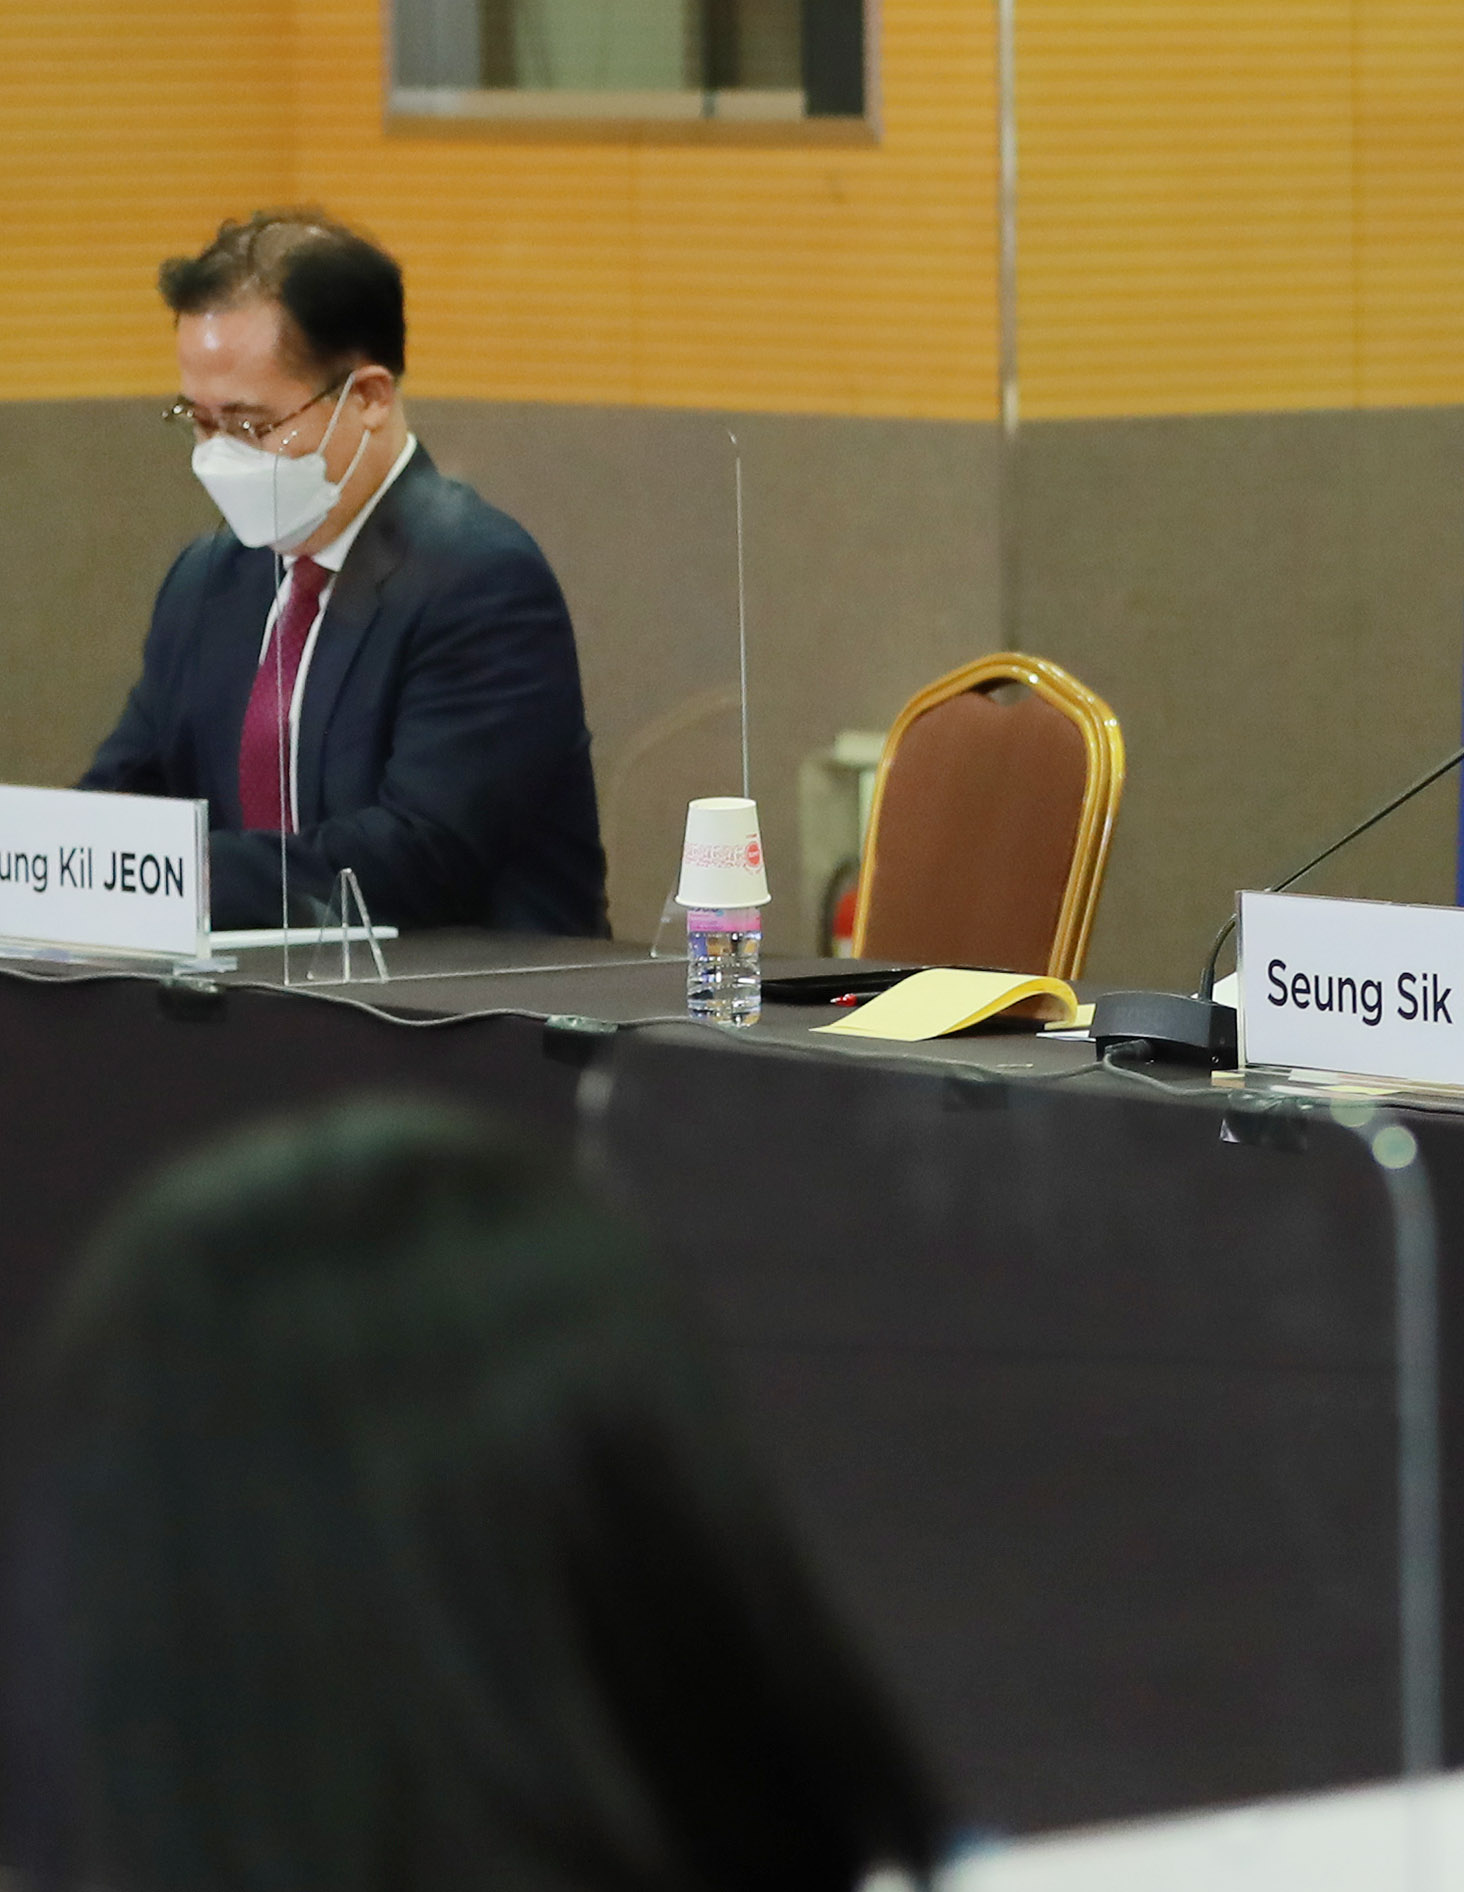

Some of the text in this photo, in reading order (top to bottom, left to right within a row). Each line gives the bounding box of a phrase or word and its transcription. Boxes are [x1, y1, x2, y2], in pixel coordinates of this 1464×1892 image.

[59, 846, 93, 889] Kil
[104, 851, 184, 898] JEON
[1267, 959, 1383, 1027] Seung
[1397, 972, 1454, 1024] Sik
